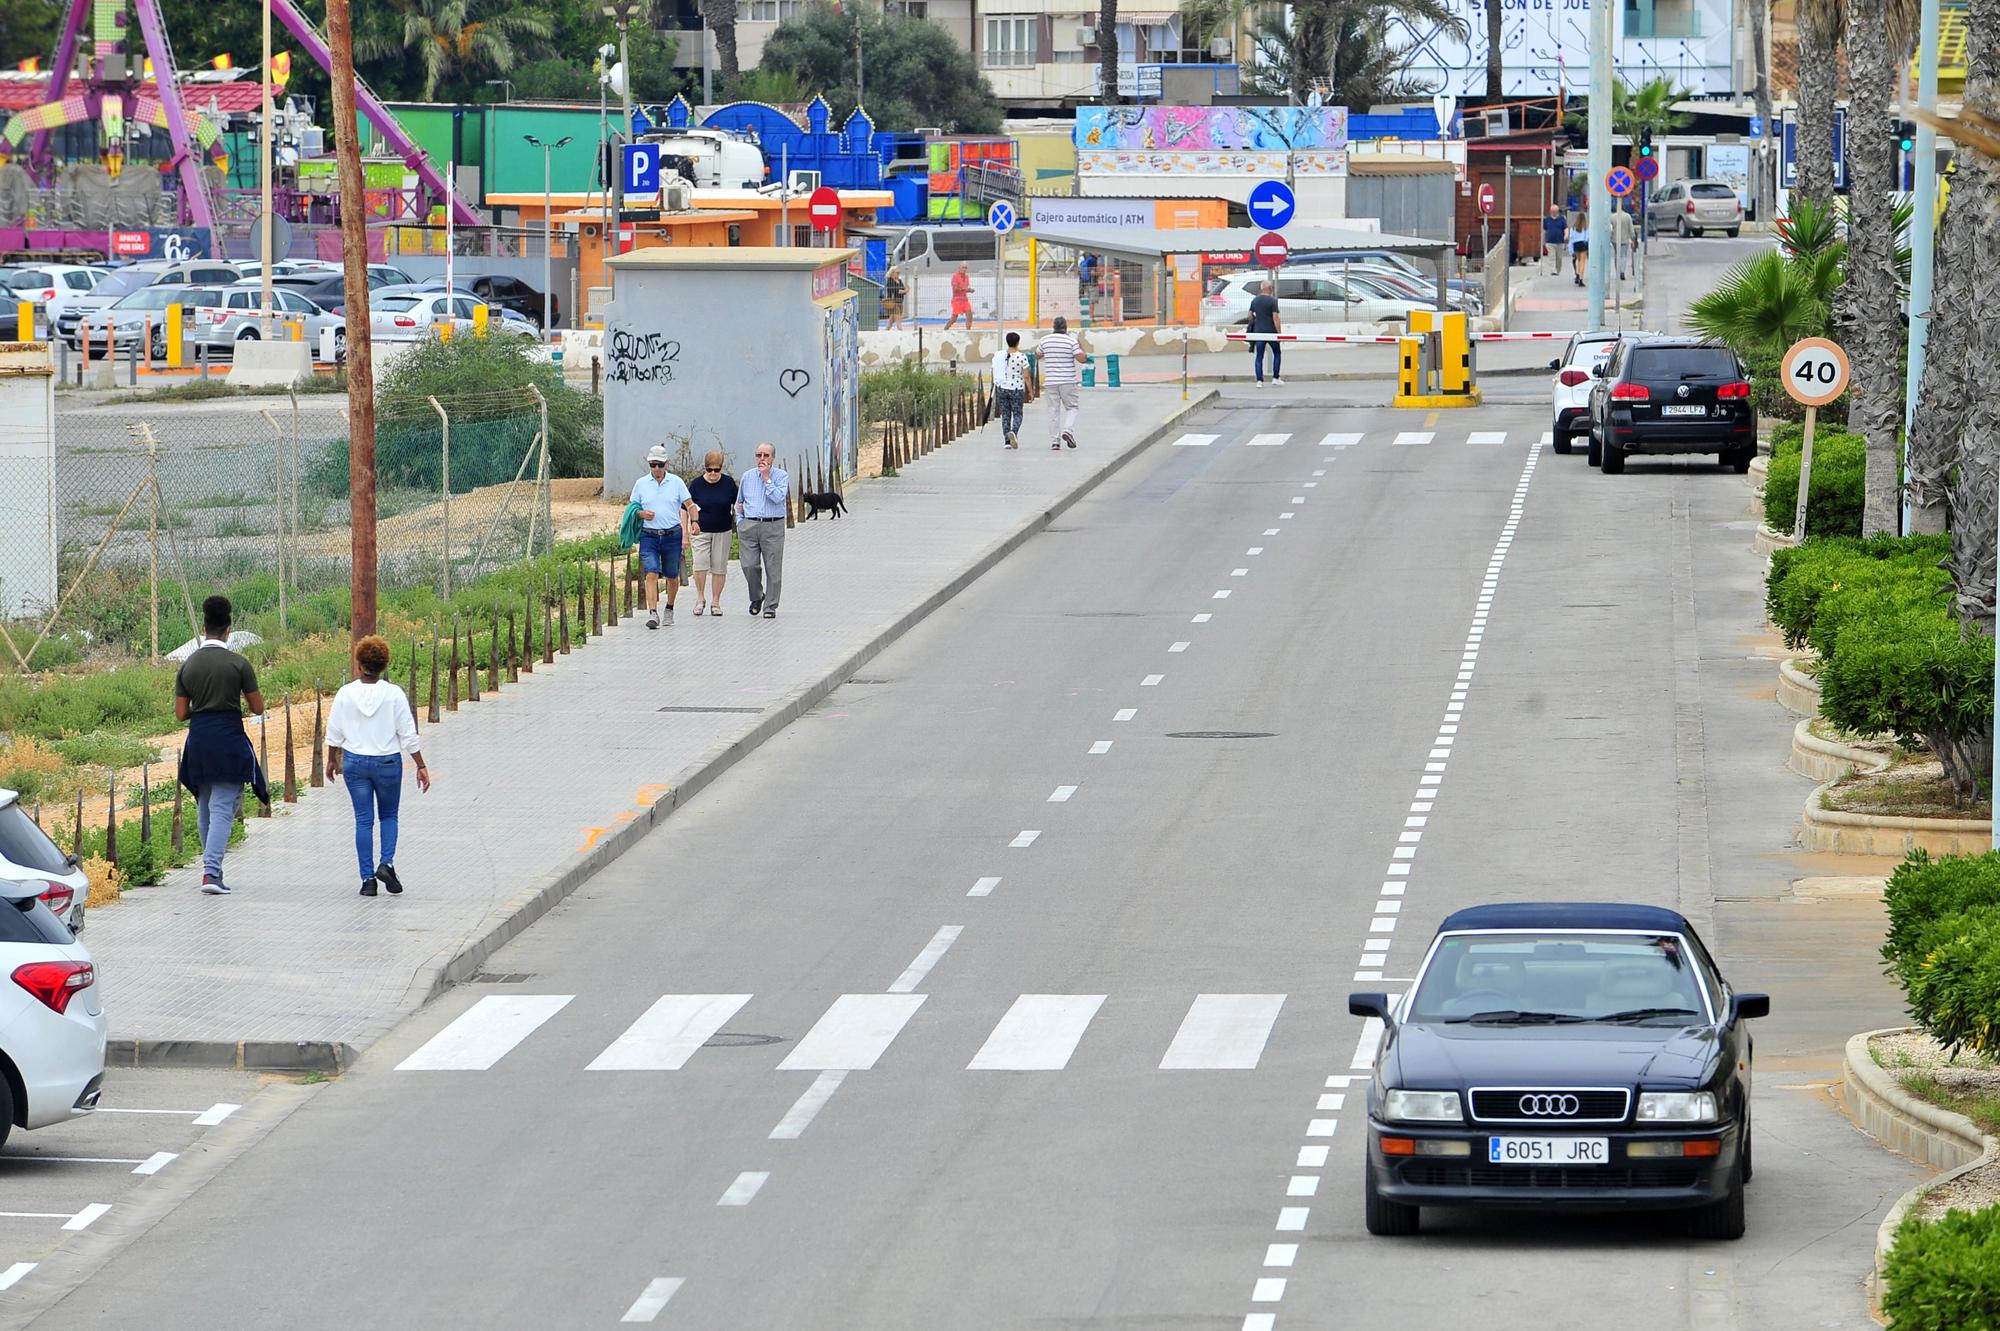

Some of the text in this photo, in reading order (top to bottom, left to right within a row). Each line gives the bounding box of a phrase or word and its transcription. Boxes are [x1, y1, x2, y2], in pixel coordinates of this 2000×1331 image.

[1533, 0, 1552, 9] DE
[633, 152, 649, 186] P
[1036, 212, 1064, 224] Cajero
[1066, 213, 1118, 224] automático
[1125, 215, 1145, 224] ATM
[1795, 361, 1836, 383] 40
[1506, 1141, 1602, 1160] 6051 JRC
